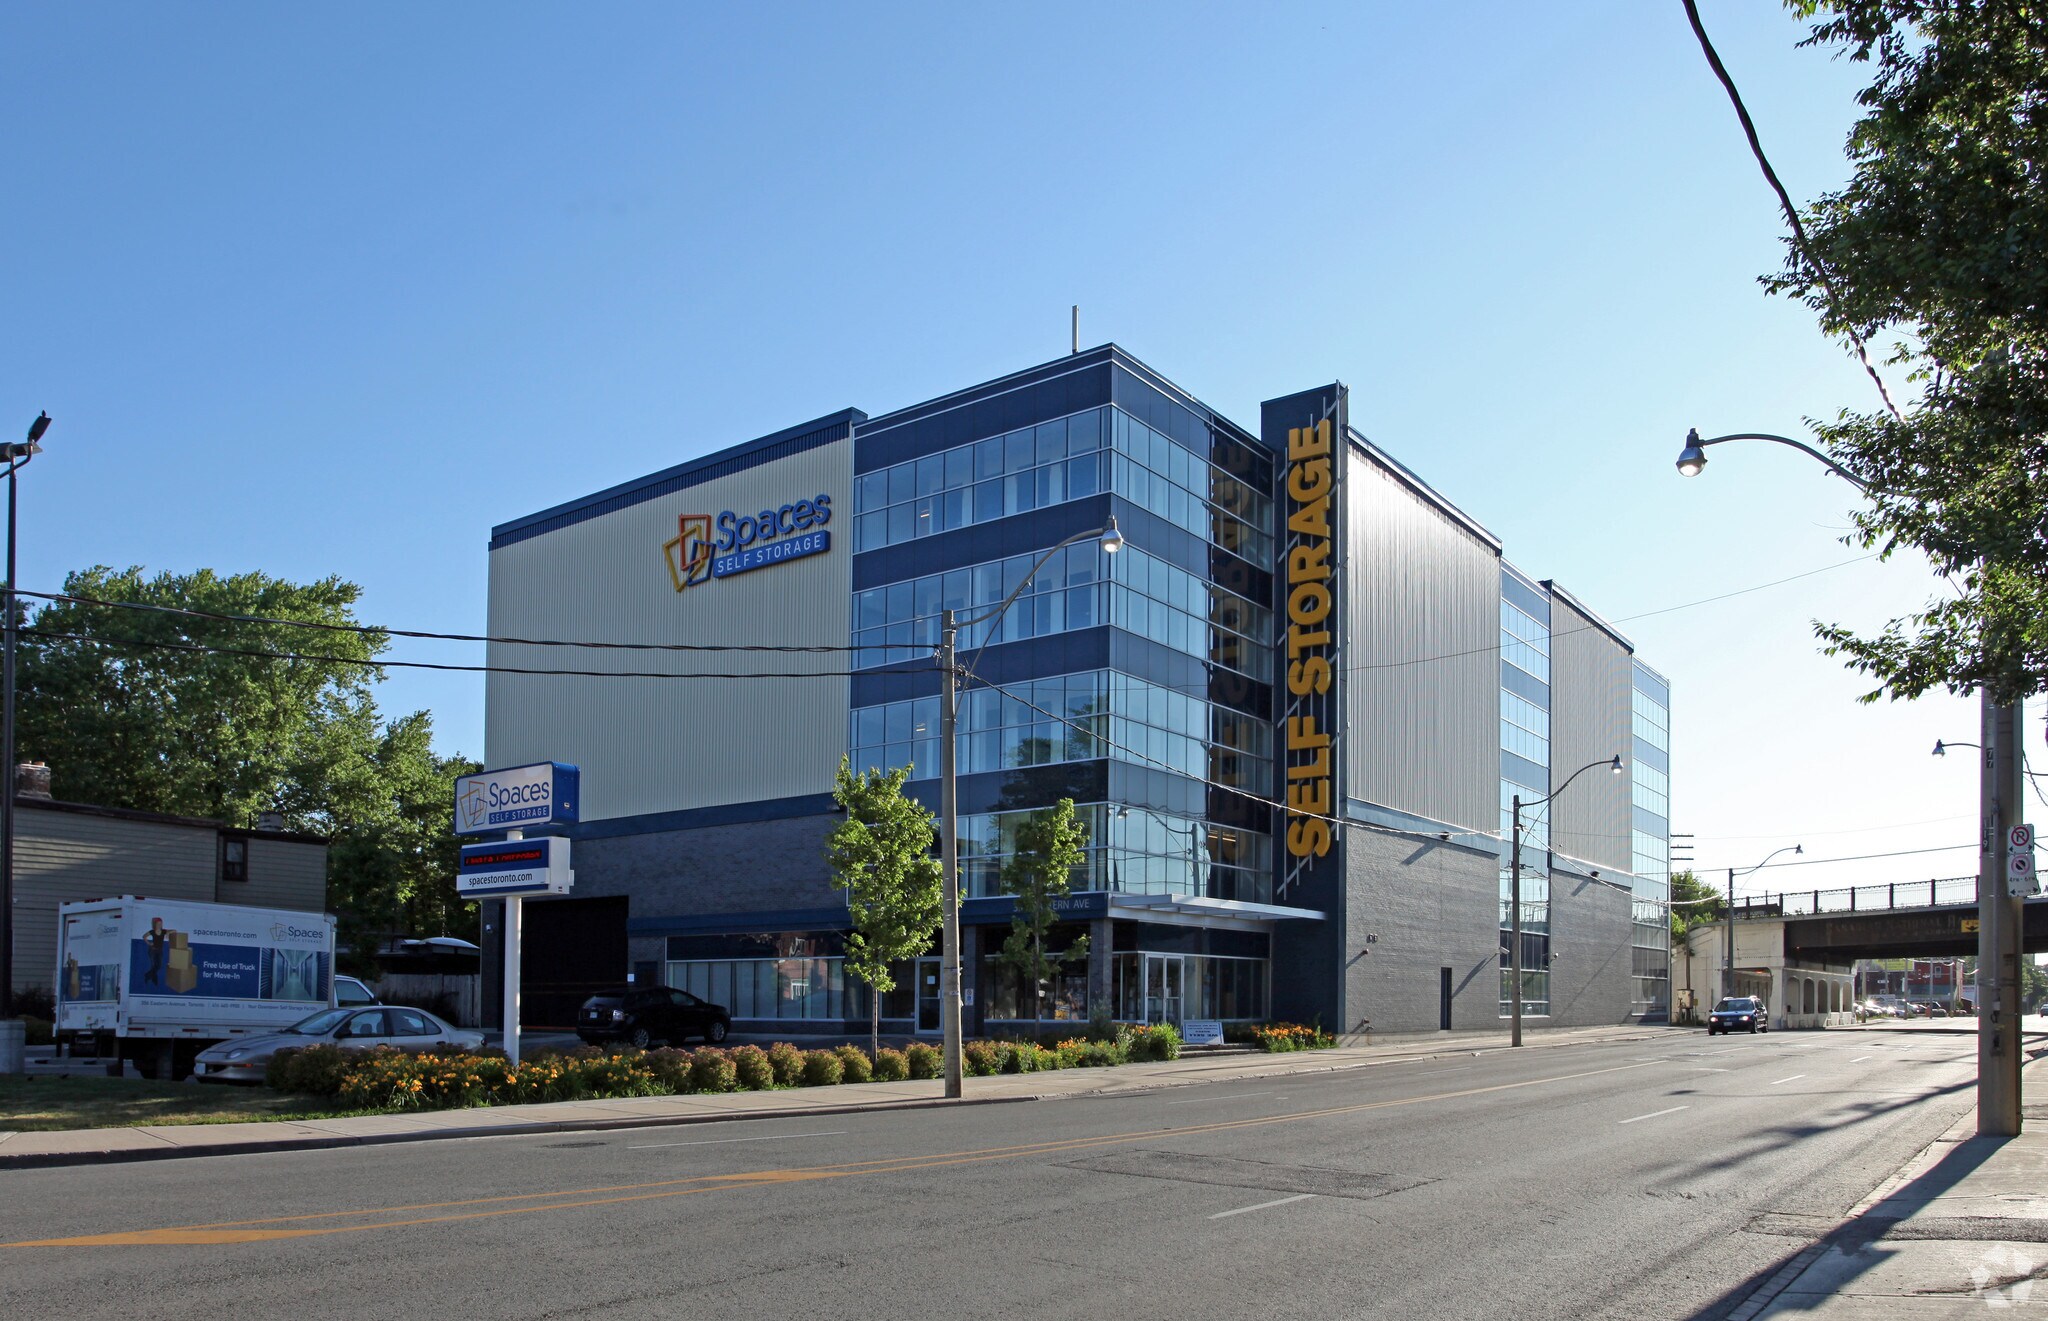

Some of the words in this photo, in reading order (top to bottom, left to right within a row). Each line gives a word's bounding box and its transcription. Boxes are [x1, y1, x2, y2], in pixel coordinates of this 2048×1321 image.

[716, 494, 831, 552] Spaces
[717, 554, 751, 573] SELF
[756, 534, 821, 563] STORAGE
[1287, 419, 1332, 697] STORAGE
[1287, 715, 1332, 859] SELF
[489, 781, 549, 810] Spaces
[491, 812, 509, 822] SELF
[512, 806, 547, 820] STORAGE
[468, 872, 533, 887] spacestoronto.com
[1073, 898, 1090, 909] AVE
[193, 929, 257, 939] spacestoronto.com
[287, 926, 324, 938] Spaces
[203, 961, 218, 969] Free
[239, 963, 256, 971] Truck
[213, 972, 241, 980] Move-In
